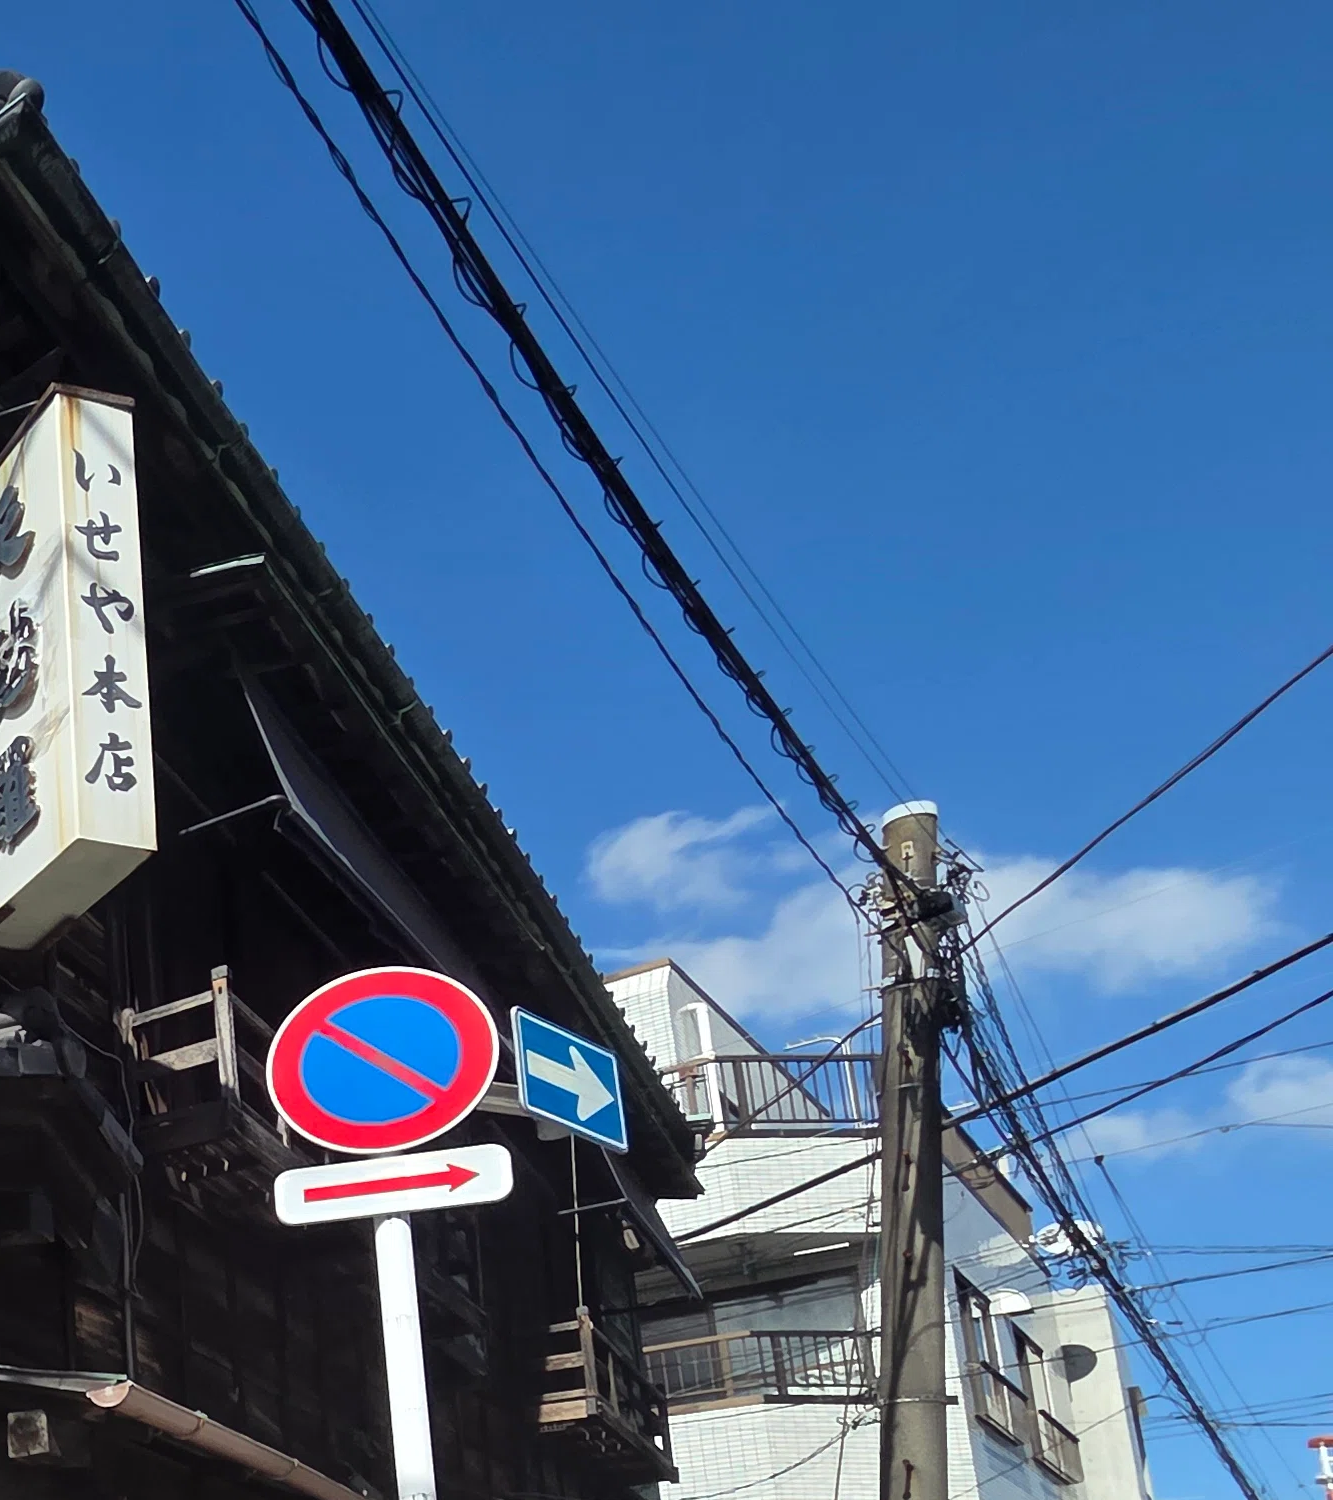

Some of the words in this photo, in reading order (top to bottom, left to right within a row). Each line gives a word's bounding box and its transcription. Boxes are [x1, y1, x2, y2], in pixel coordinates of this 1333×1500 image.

[72, 447, 143, 793] いせや本店
